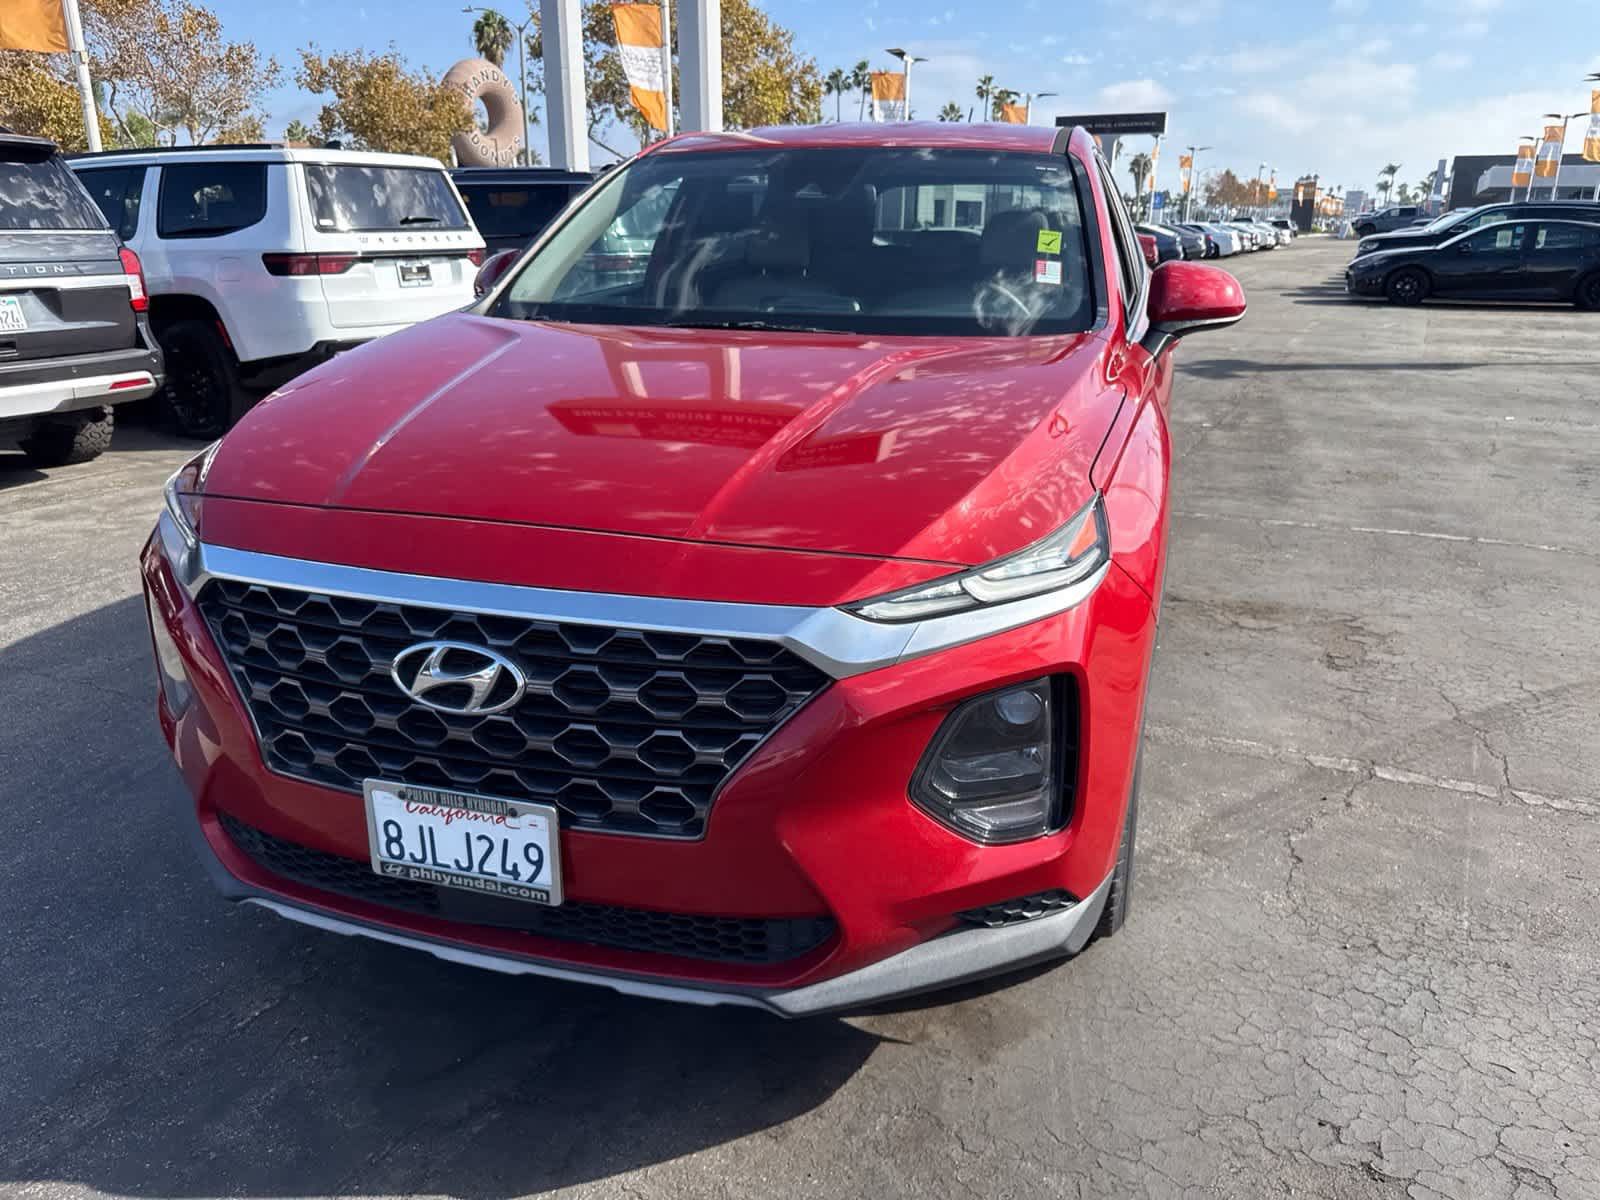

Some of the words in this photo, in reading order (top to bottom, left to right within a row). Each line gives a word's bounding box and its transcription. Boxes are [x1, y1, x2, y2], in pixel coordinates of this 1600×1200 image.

[471, 133, 521, 162] DONUTS
[405, 802, 520, 830] California
[440, 793, 465, 808] HILLS
[466, 797, 508, 816] HYUNDAI
[383, 819, 544, 884] 8JLJ249
[409, 867, 548, 902] phhyundai.com
